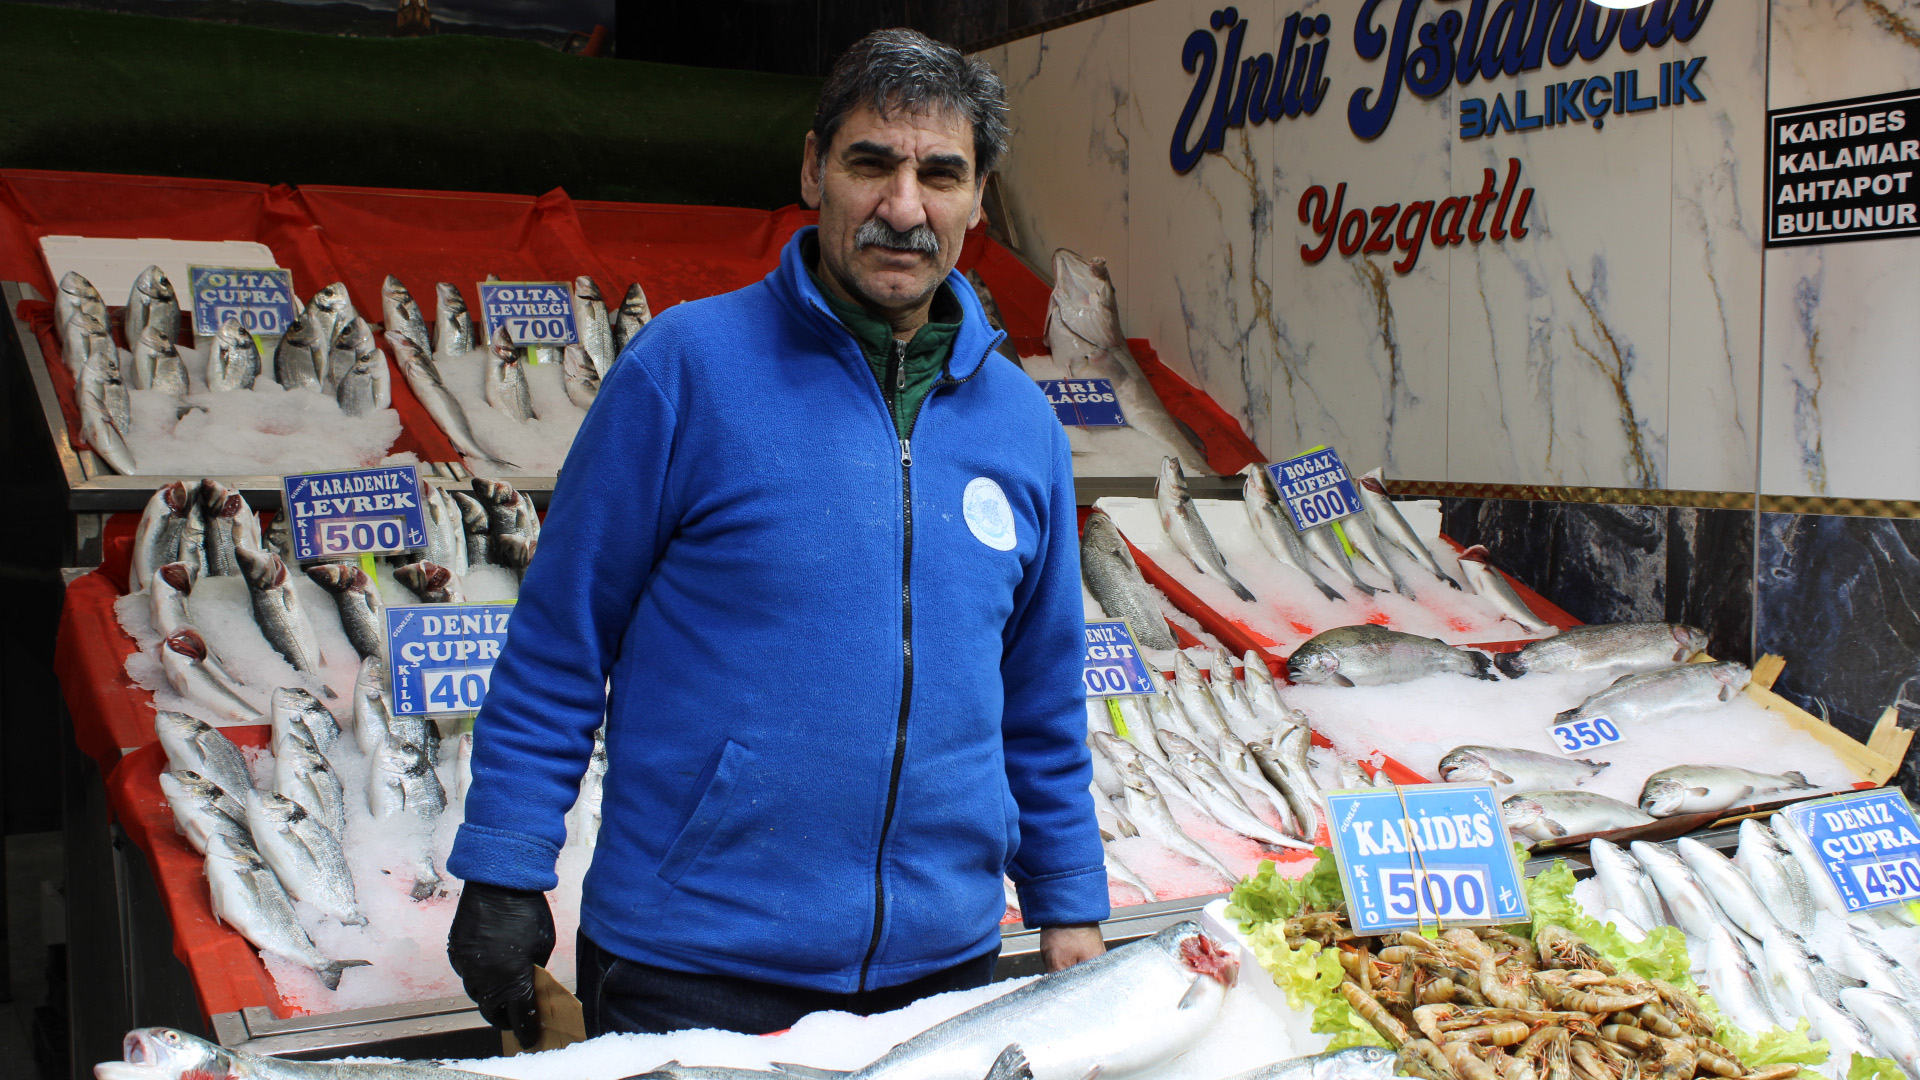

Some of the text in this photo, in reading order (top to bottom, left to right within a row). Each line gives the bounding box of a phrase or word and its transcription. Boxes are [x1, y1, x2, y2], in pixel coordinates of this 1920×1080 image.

[1170, 7, 1331, 174] Ünlü
[1459, 56, 1707, 139] BALIKÇILIK
[1779, 109, 1906, 145] KARİDES
[1778, 139, 1920, 175] KALAMAR
[1777, 171, 1913, 205] AHTAPOT
[1299, 157, 1535, 274] Yozgatlı
[1777, 203, 1918, 235] BULUNUR
[200, 289, 289, 305] ÇUPRA
[208, 273, 278, 289] OLTA
[497, 289, 561, 302] OLTA
[488, 300, 570, 316] LEVREĞİ
[513, 319, 565, 339] 700
[1046, 393, 1115, 404] LAGOS
[1057, 381, 1098, 393] İRİ
[309, 470, 400, 497] KARADENİZ
[1282, 465, 1348, 498] LÜFERİ
[1284, 455, 1333, 480] BOĞAZ
[294, 492, 417, 518] LEVREK
[1300, 490, 1345, 523] 600
[296, 519, 312, 557] KİLO
[325, 522, 401, 552] 500
[422, 609, 510, 636] DENİZ
[1085, 625, 1116, 643] ENİZ
[401, 639, 500, 668] ÇUPR
[1085, 642, 1133, 660] GİT
[398, 664, 413, 712] KİLO
[430, 673, 487, 709] 40
[1082, 668, 1126, 693] 00
[1554, 718, 1620, 751] 350
[1352, 808, 1494, 857] KARİDES
[1822, 800, 1895, 833] DENİZ
[1822, 826, 1920, 864] ÇUPRA
[1352, 864, 1379, 924] KİLO
[1387, 872, 1485, 916] 500
[1828, 861, 1860, 908] KİLO
[1865, 861, 1920, 898] 450
